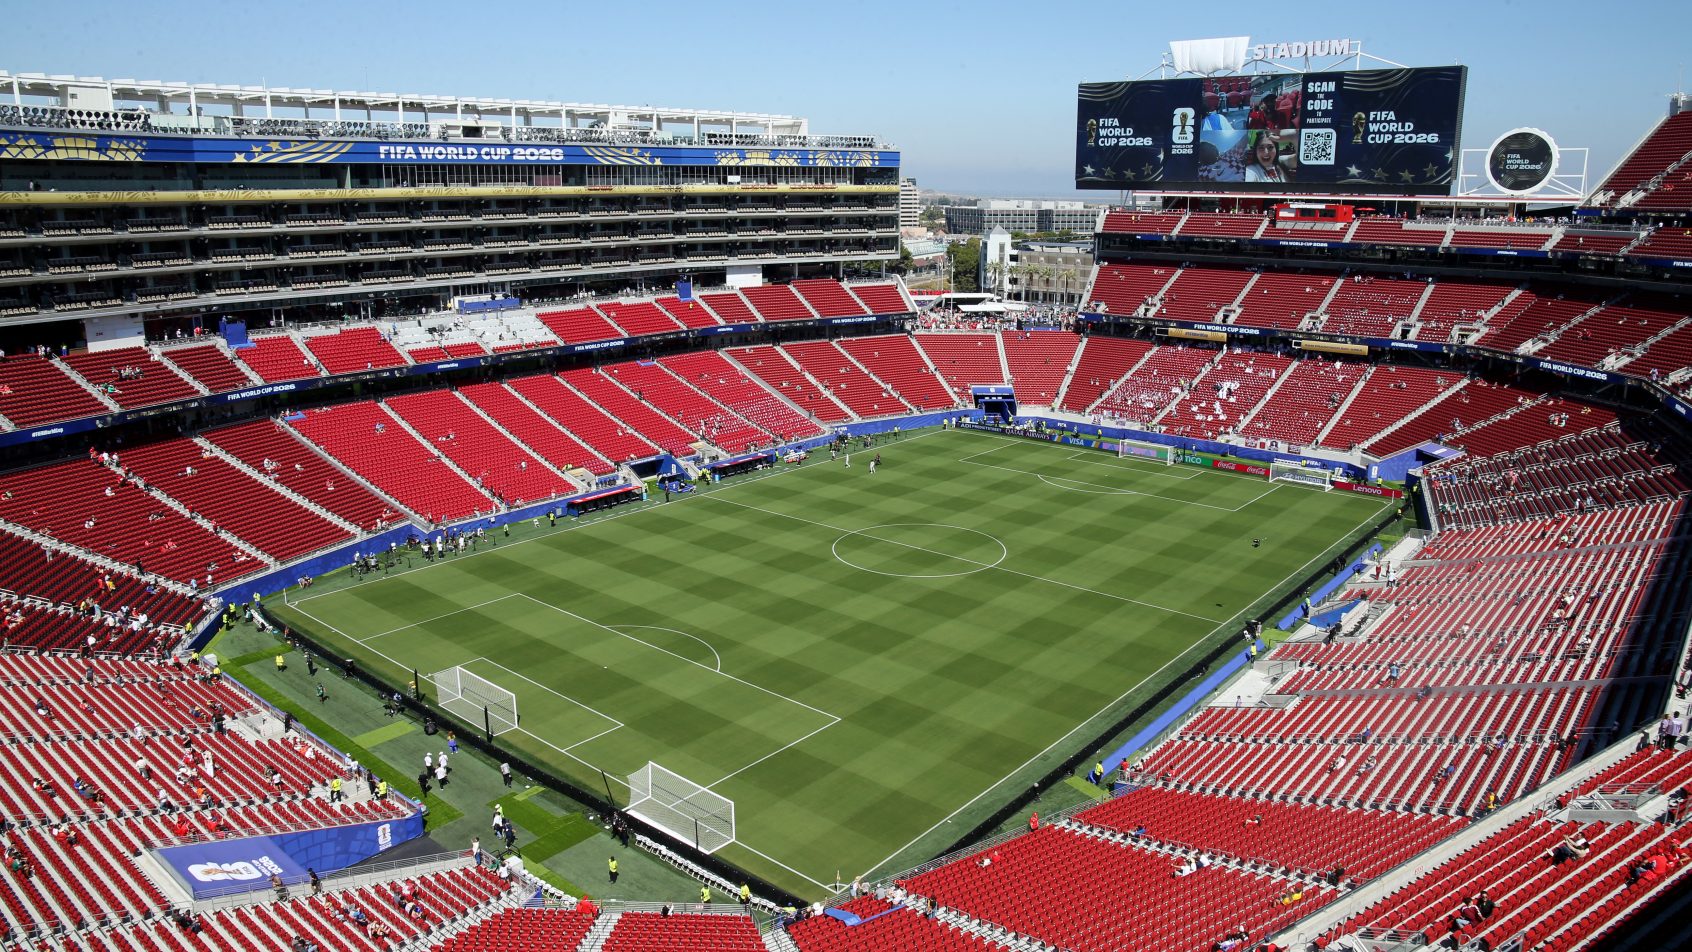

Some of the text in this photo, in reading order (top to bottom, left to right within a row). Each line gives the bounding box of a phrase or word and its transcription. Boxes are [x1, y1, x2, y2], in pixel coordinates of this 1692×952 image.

[1253, 38, 1350, 60] STADIUM
[1308, 82, 1336, 93] SCAN
[1307, 100, 1333, 110] CODE
[1369, 111, 1395, 121] FIFA
[1099, 118, 1119, 126] FIFA
[1368, 122, 1413, 132] WORLD
[1099, 128, 1133, 136] WORLD
[1099, 137, 1152, 146] CUP 2026
[1368, 134, 1439, 144] CUP 2026
[380, 145, 564, 160] FIFA WORLD CUP 2026
[1540, 362, 1607, 380] FIFA WORLD CUP 2026
[228, 384, 296, 401] FIFA WORLD CUP 2026
[1026, 432, 1050, 440] AIRWAYS
[1069, 437, 1084, 446] VISA
[1353, 485, 1382, 495] Lenovo
